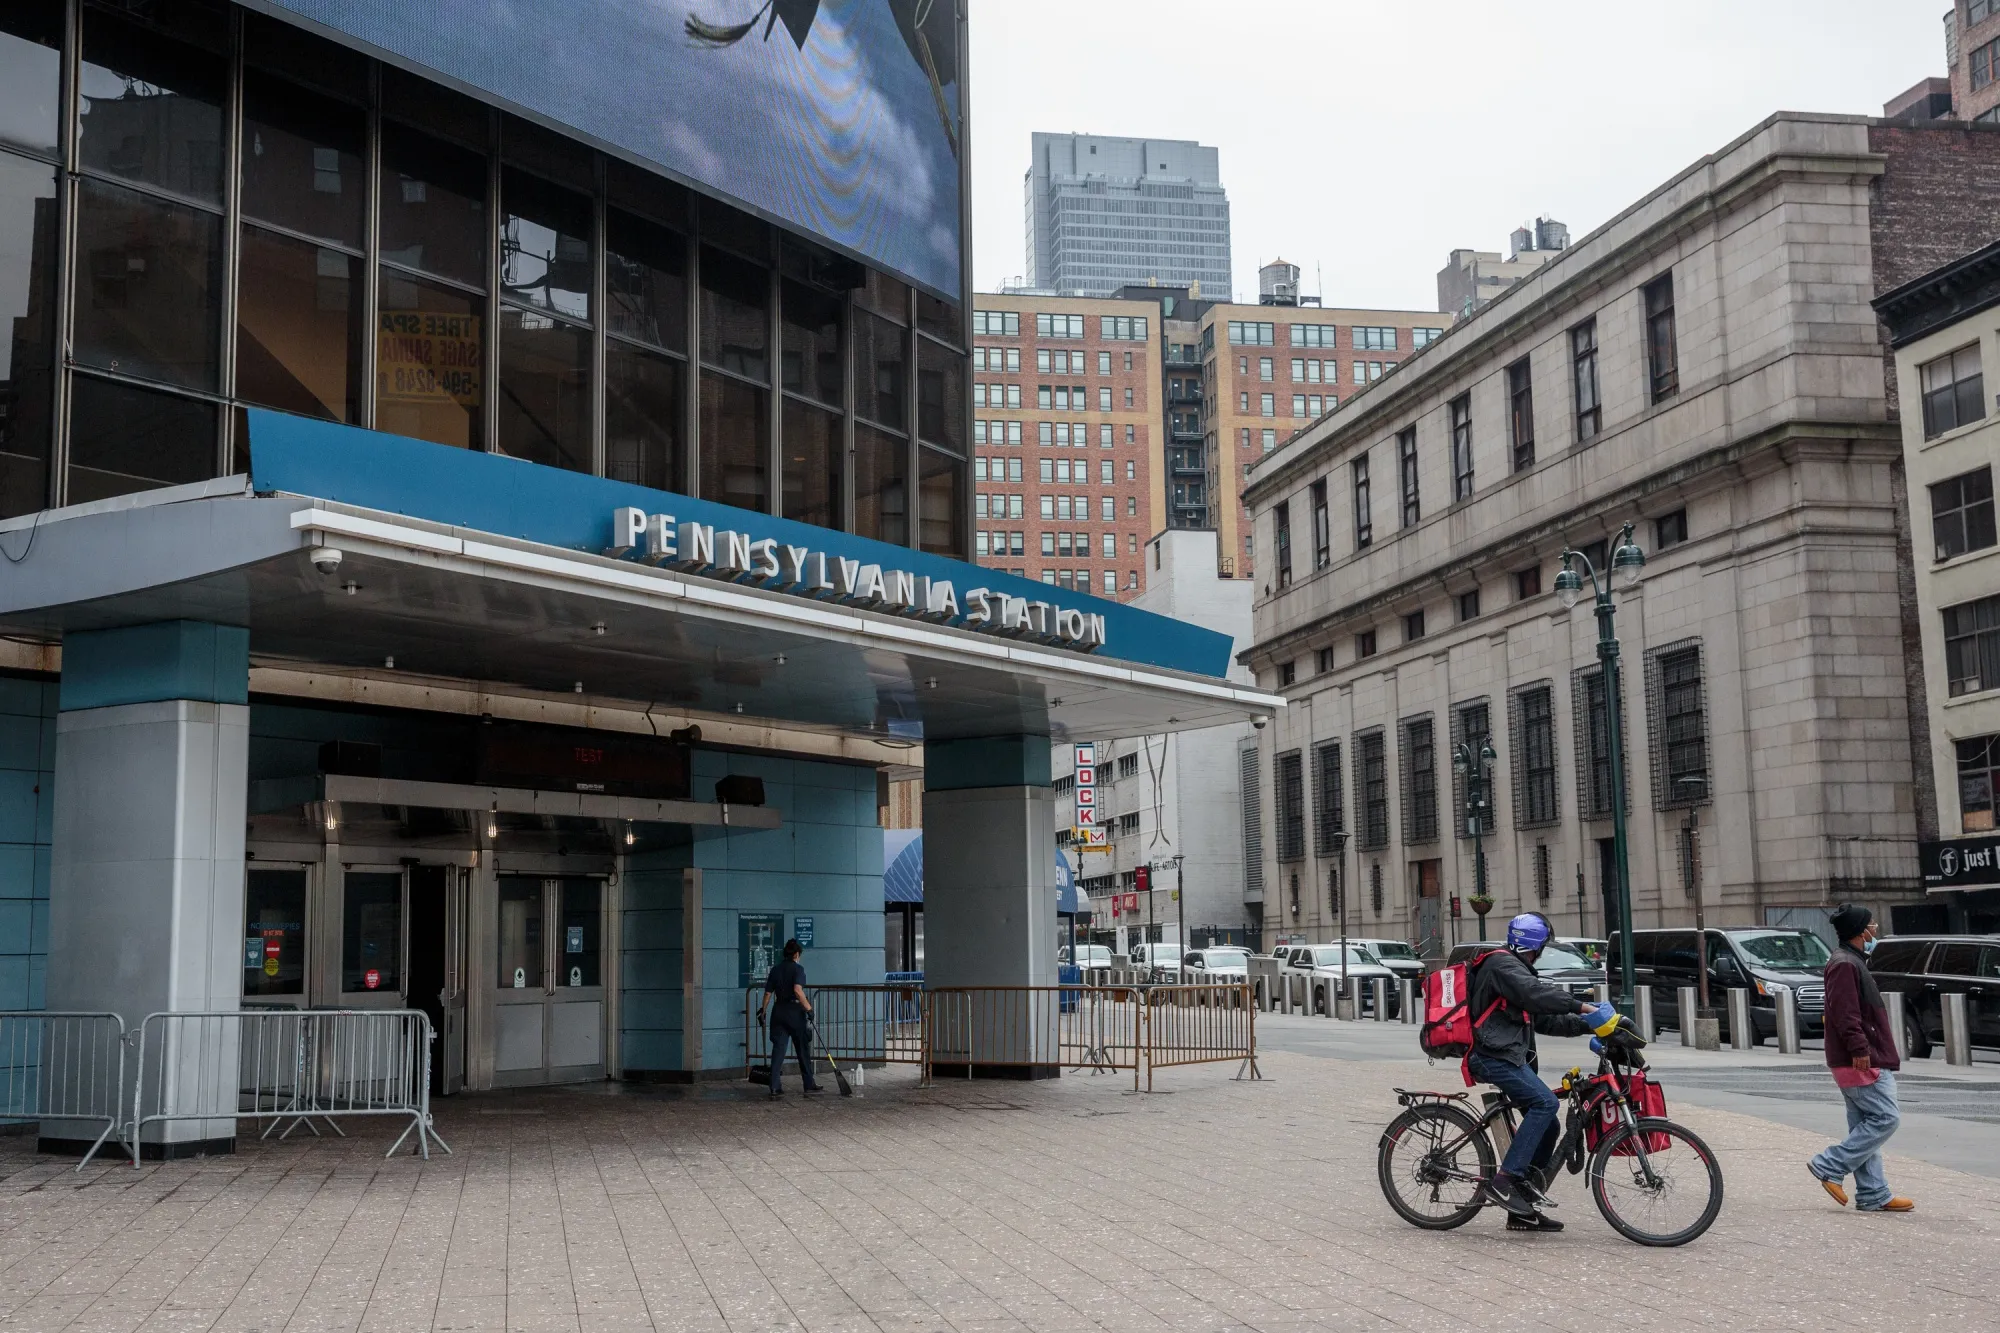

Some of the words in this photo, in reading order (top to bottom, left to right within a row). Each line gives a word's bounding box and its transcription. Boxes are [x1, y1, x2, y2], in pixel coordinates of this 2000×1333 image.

[613, 505, 960, 616] PENNSYLVANIA
[965, 587, 1106, 645] STATION
[574, 747, 603, 763] TEST
[1078, 749, 1093, 823] LOCK
[1963, 847, 1991, 872] just
